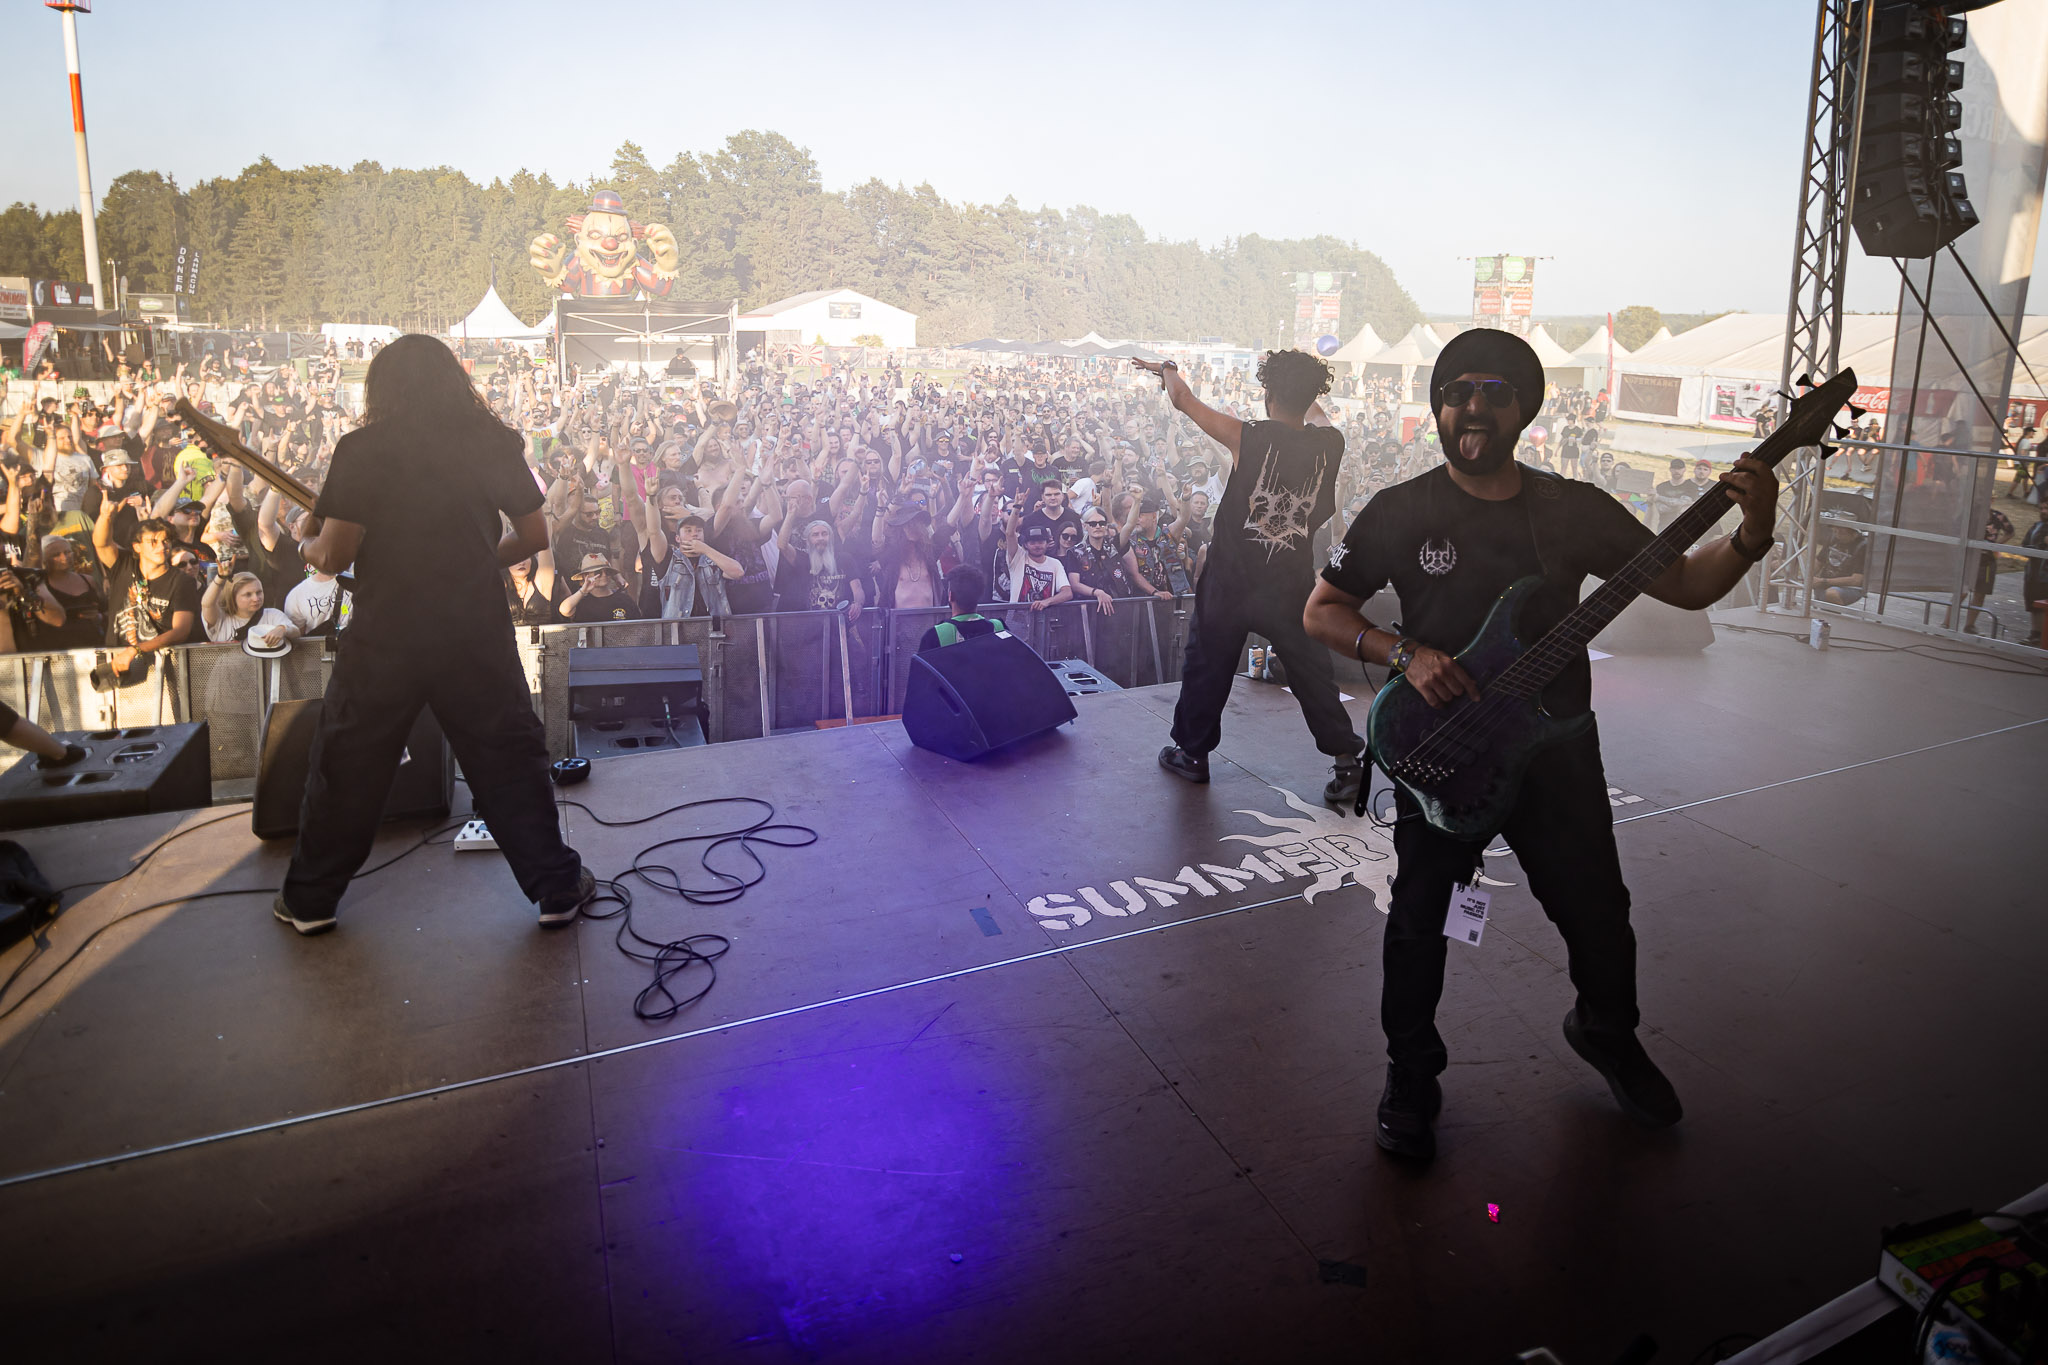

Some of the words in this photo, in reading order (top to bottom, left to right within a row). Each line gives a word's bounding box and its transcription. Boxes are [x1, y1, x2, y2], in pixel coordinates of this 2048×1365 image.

[175, 246, 187, 293] DÖNER
[188, 251, 200, 295] LAHMACUN
[1025, 834, 1389, 931] SUMMER
[1463, 910, 1483, 919] PASSION
